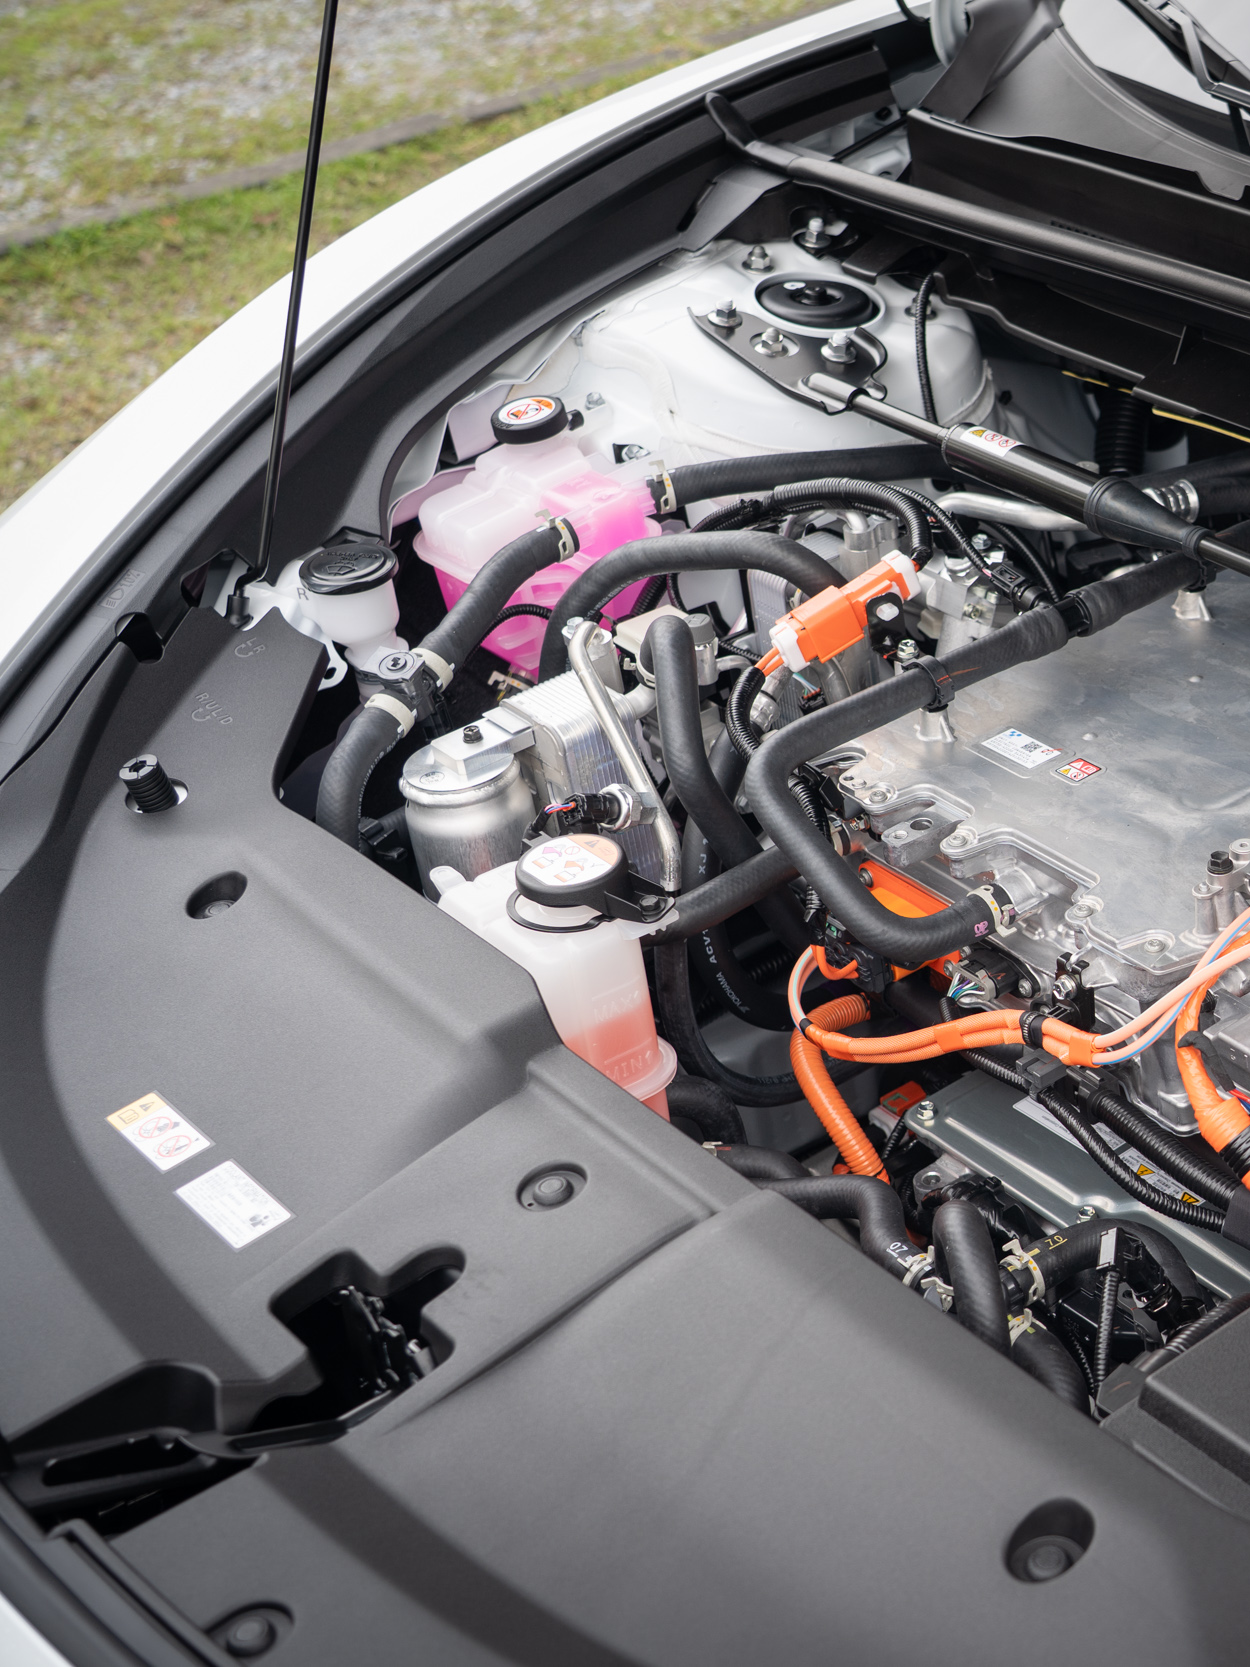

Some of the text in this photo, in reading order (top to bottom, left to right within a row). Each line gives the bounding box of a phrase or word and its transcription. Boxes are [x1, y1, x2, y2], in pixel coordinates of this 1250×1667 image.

[296, 587, 309, 601] R
[715, 971, 742, 1009] YOKOHAMA
[1045, 1234, 1063, 1250] 70
